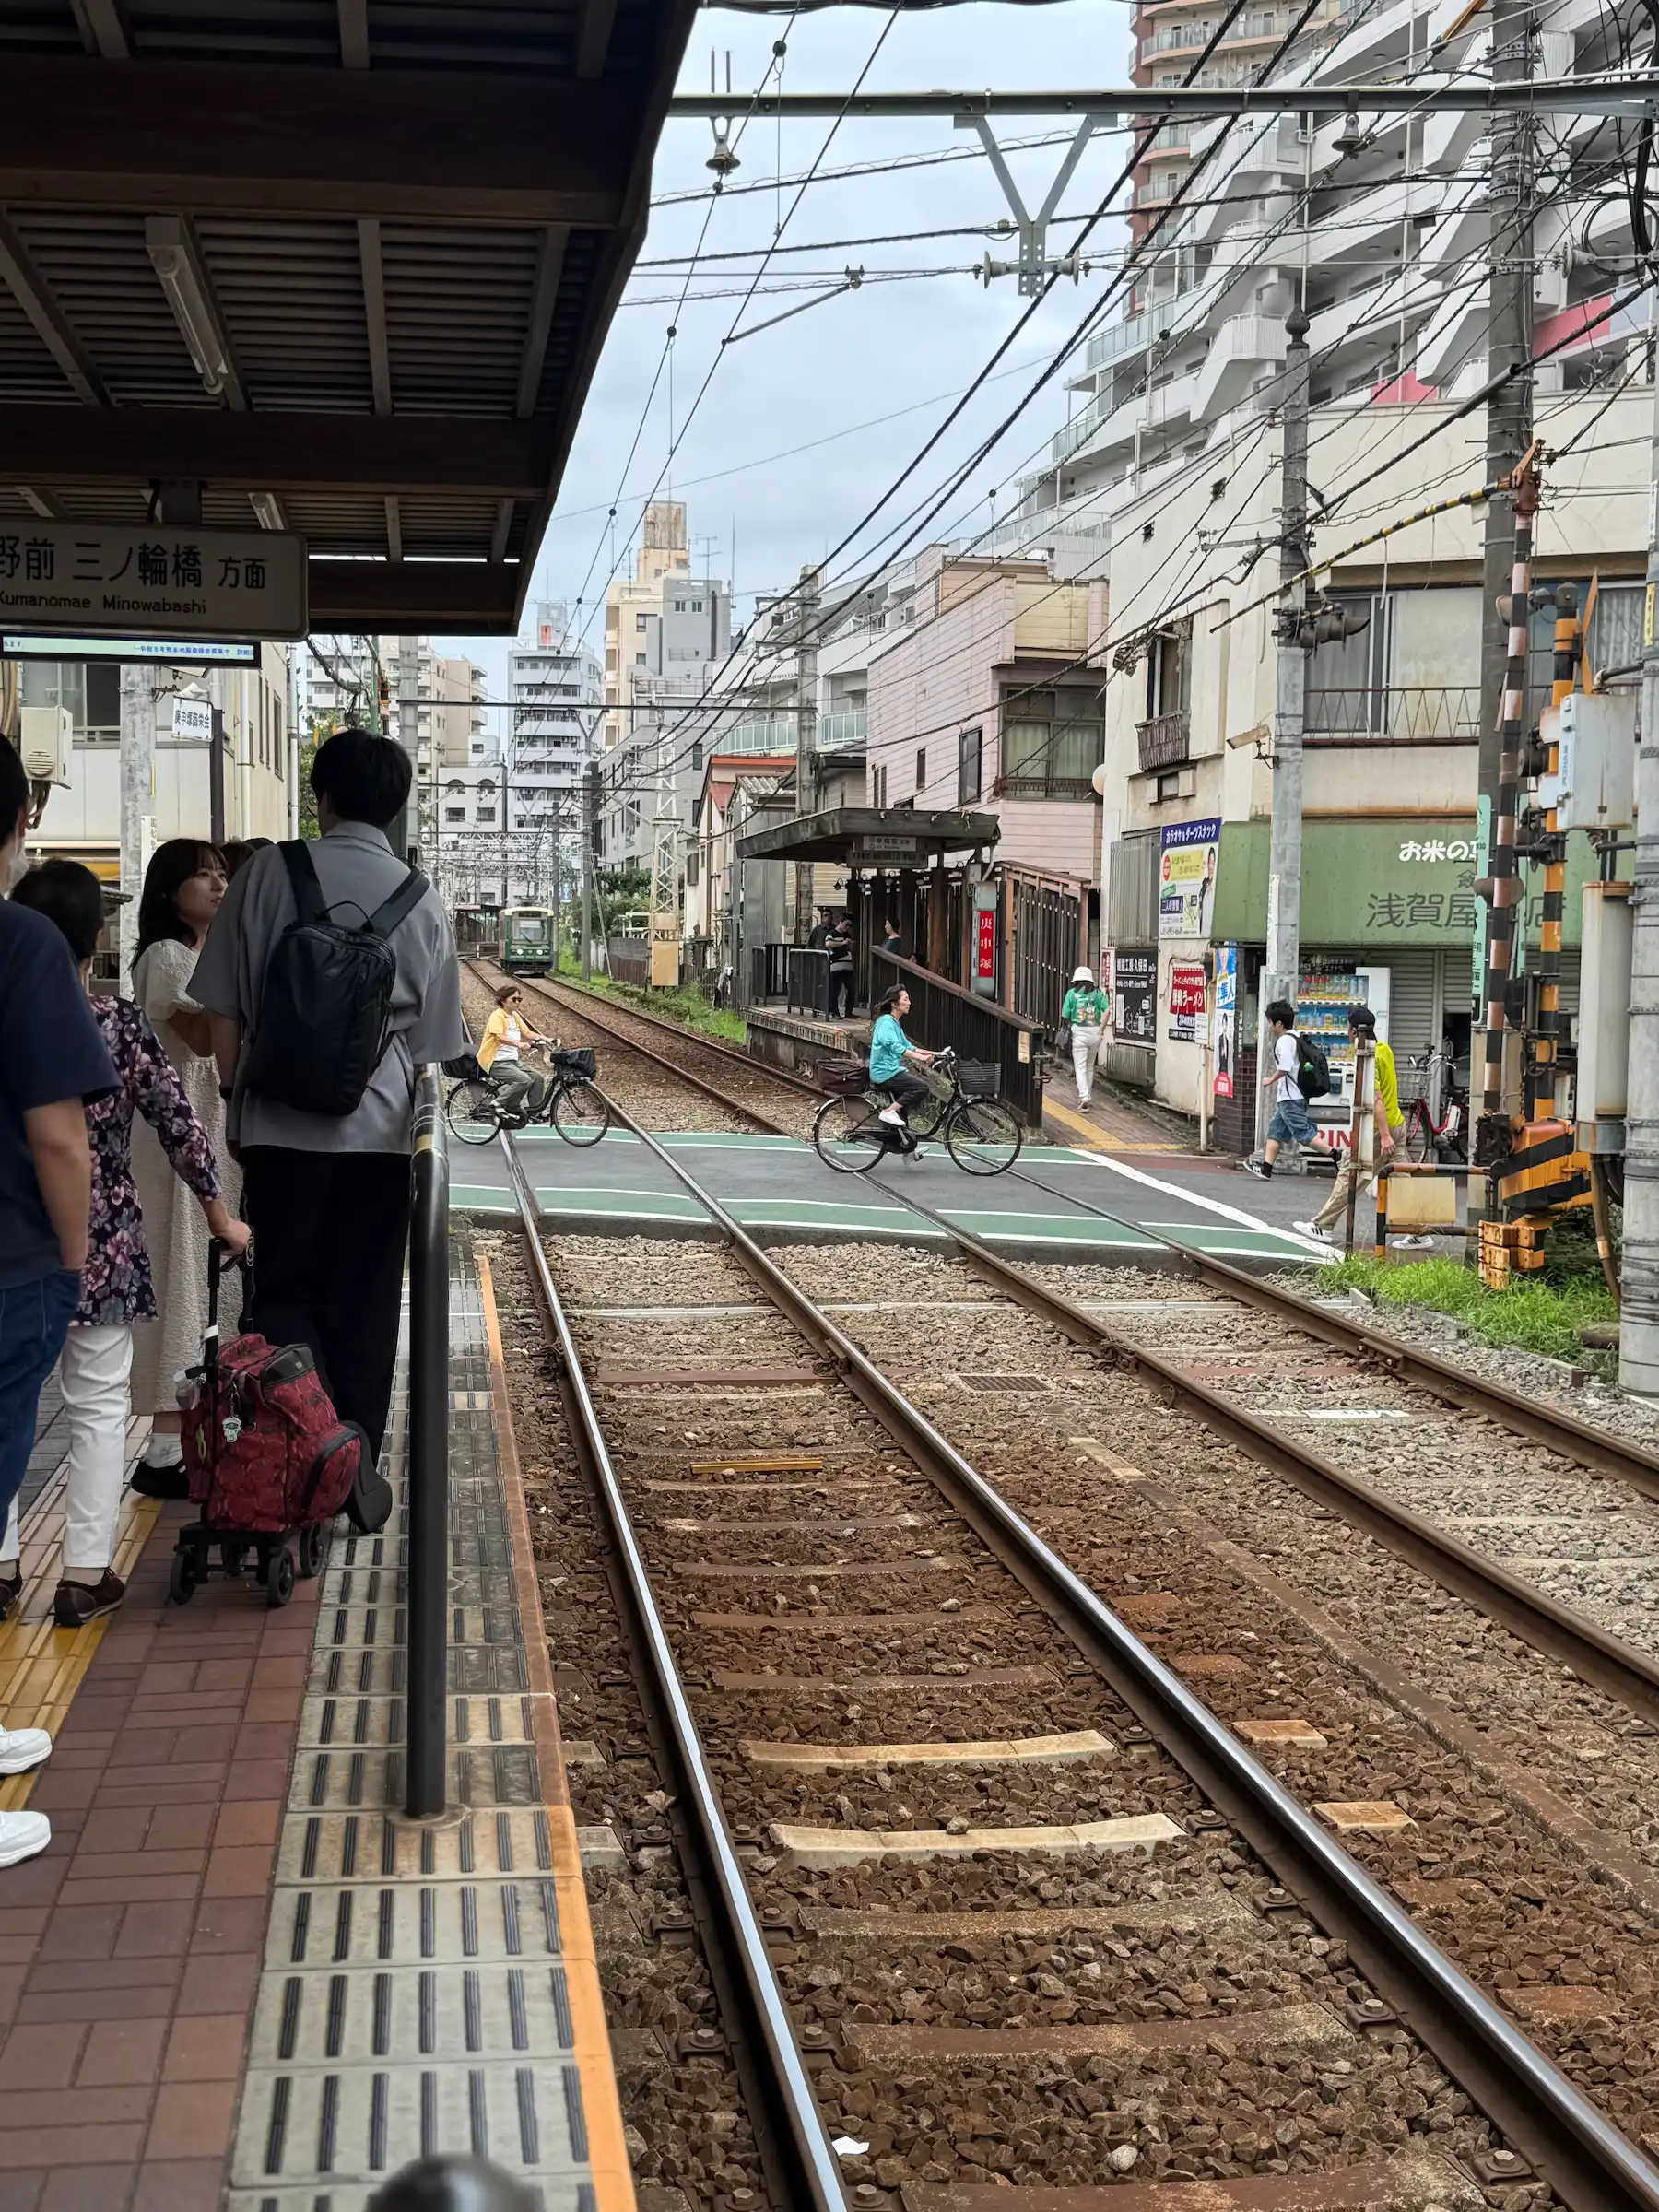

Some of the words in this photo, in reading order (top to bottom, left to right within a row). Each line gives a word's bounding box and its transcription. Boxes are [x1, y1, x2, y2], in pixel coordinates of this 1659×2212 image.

[0, 535, 55, 581] 野前
[72, 542, 202, 588] 三ノ輪橋
[218, 556, 268, 590] 方面
[102, 594, 206, 614] Minowabashi
